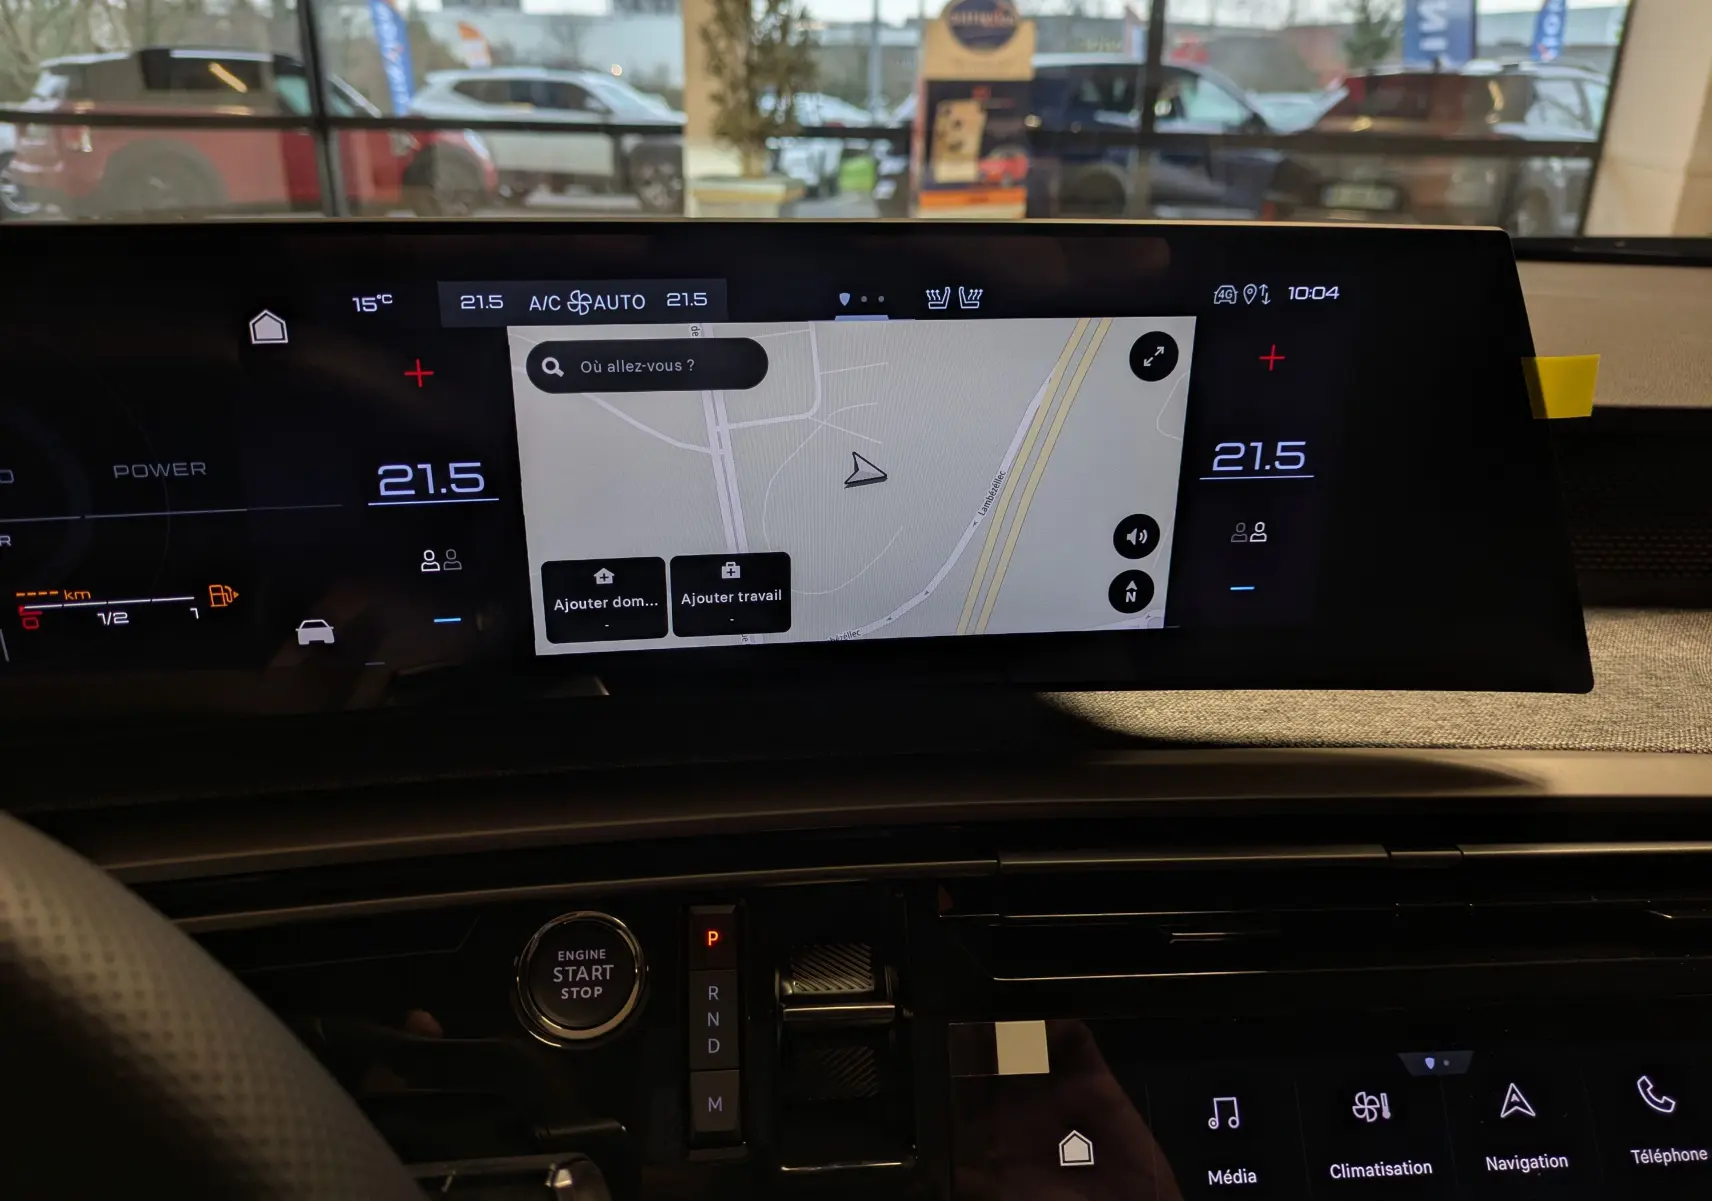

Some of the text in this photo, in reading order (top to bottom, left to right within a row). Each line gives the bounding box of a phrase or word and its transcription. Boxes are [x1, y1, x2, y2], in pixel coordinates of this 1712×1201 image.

[666, 292, 708, 307] 21.5
[1218, 289, 1233, 299] 4G
[1288, 286, 1340, 300] 10:04
[460, 294, 504, 310] 21.5
[529, 294, 646, 311] A/C AUTO
[580, 359, 602, 374] Où
[607, 359, 682, 373] allez-vous
[1211, 441, 1307, 471] 21.5
[113, 461, 207, 479] POWER
[377, 461, 486, 495] 21.5
[63, 589, 92, 600] km
[680, 589, 782, 607] Ajouter travail
[1125, 591, 1137, 603] N
[553, 598, 609, 613] Ajouter
[96, 611, 130, 626] 1/2
[706, 930, 719, 946] P
[557, 949, 607, 961] ENGINE
[552, 964, 615, 982] START
[560, 986, 603, 1000] STOP
[708, 985, 719, 1001] R
[707, 1011, 719, 1027] N
[708, 1038, 720, 1054] D
[708, 1096, 723, 1112] M
[1485, 1153, 1569, 1174] Navigation
[1630, 1147, 1709, 1167] Téléphone
[1207, 1168, 1258, 1186] Média
[1329, 1159, 1433, 1179] Climatisation
